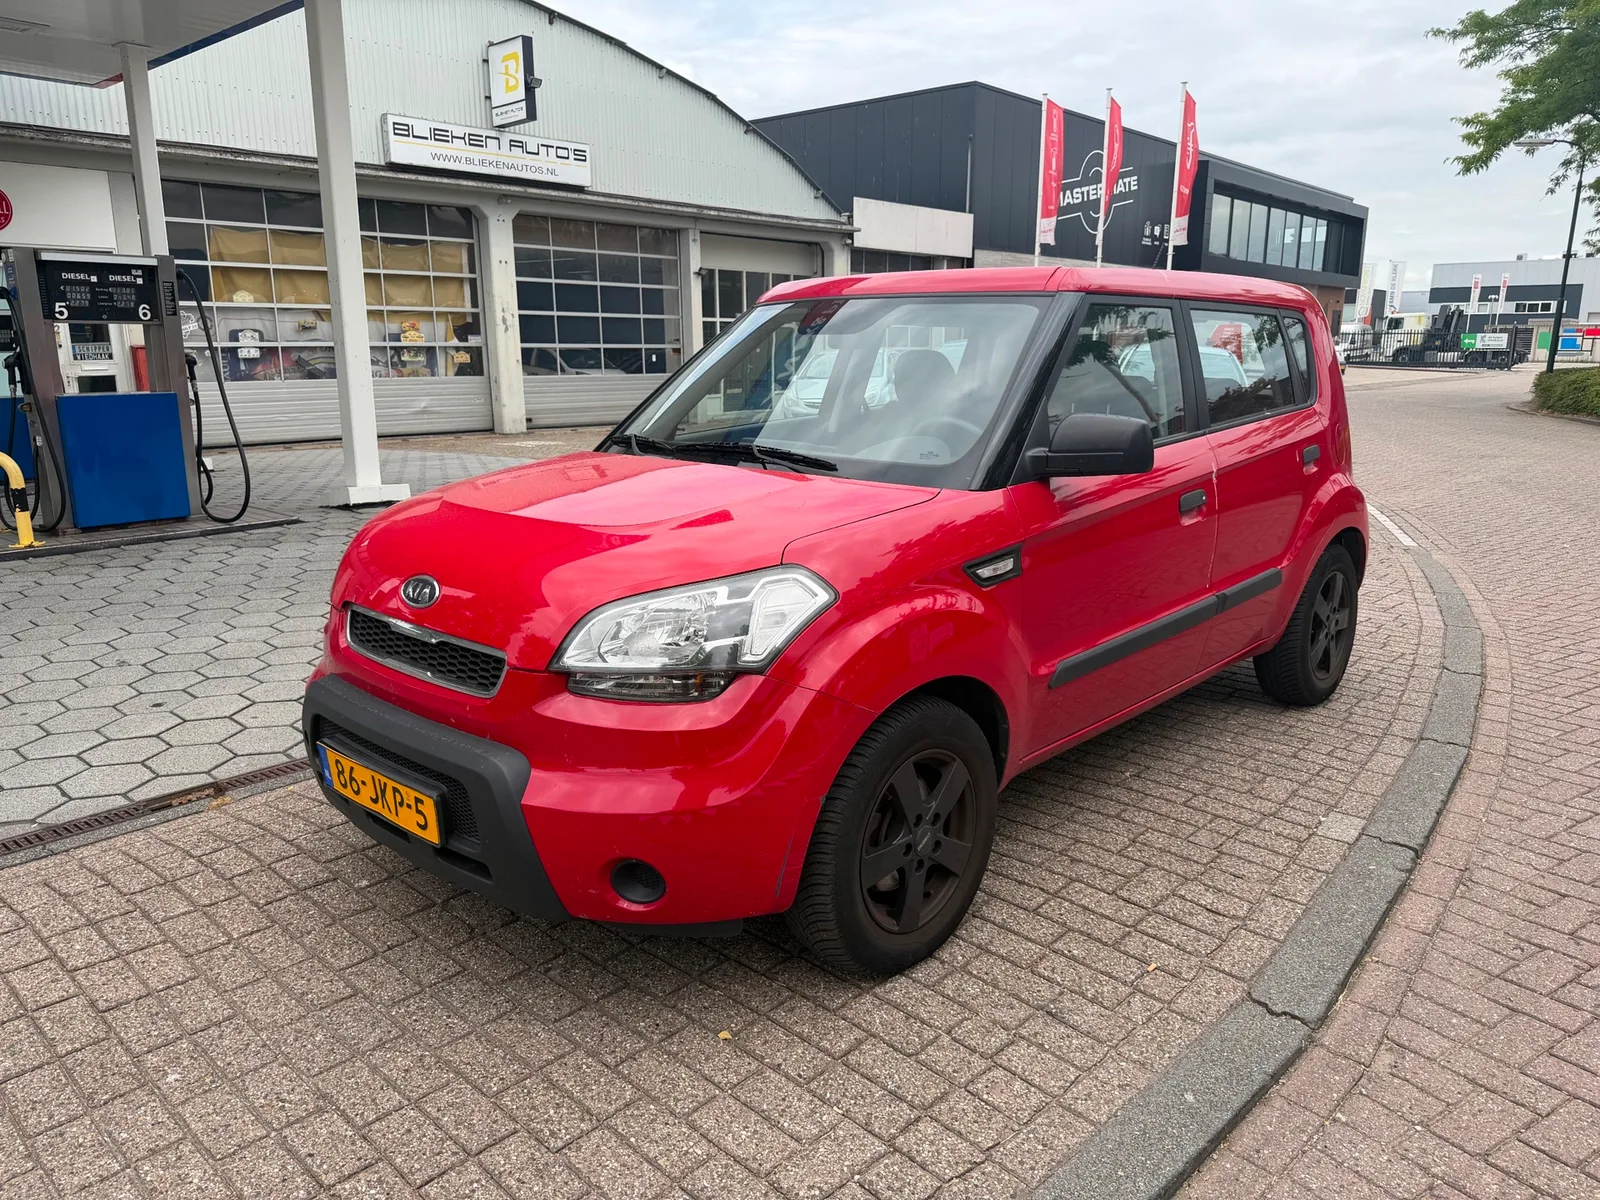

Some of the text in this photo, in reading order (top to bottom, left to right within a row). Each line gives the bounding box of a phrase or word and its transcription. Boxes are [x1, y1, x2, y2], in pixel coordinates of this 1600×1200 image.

[392, 121, 587, 163] BLIEKEN AUTO'S
[430, 152, 559, 177] WWW.BLIEKENAUTOS.NL
[1060, 175, 1138, 207] ASTERATE
[61, 272, 90, 280] DIESEL
[108, 274, 137, 282] DIESEL
[54, 302, 69, 320] 5
[138, 304, 152, 321] 6
[405, 580, 431, 603] KIA
[334, 758, 429, 831] 86-JKP-5
